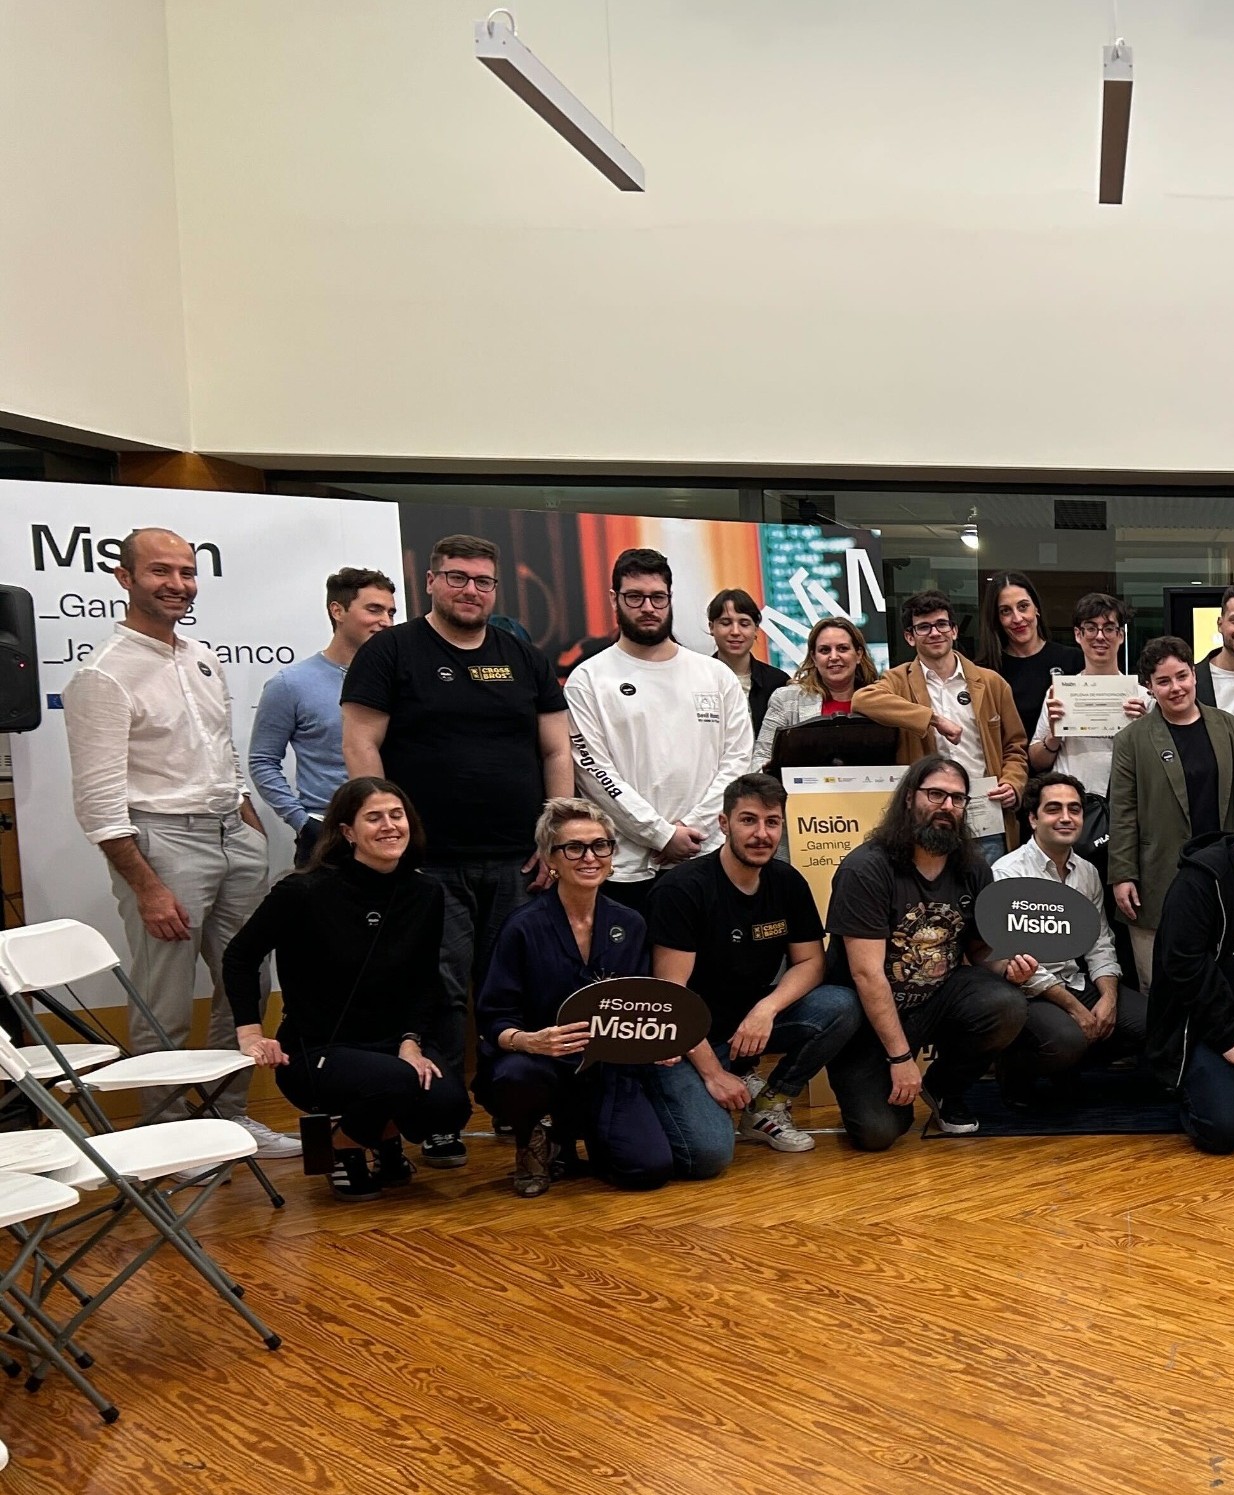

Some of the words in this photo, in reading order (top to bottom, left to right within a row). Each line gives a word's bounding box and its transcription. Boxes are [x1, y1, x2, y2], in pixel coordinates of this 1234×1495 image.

[31, 524, 223, 577] Misn
[1011, 900, 1064, 913] #Somos
[599, 998, 673, 1013] #Somos
